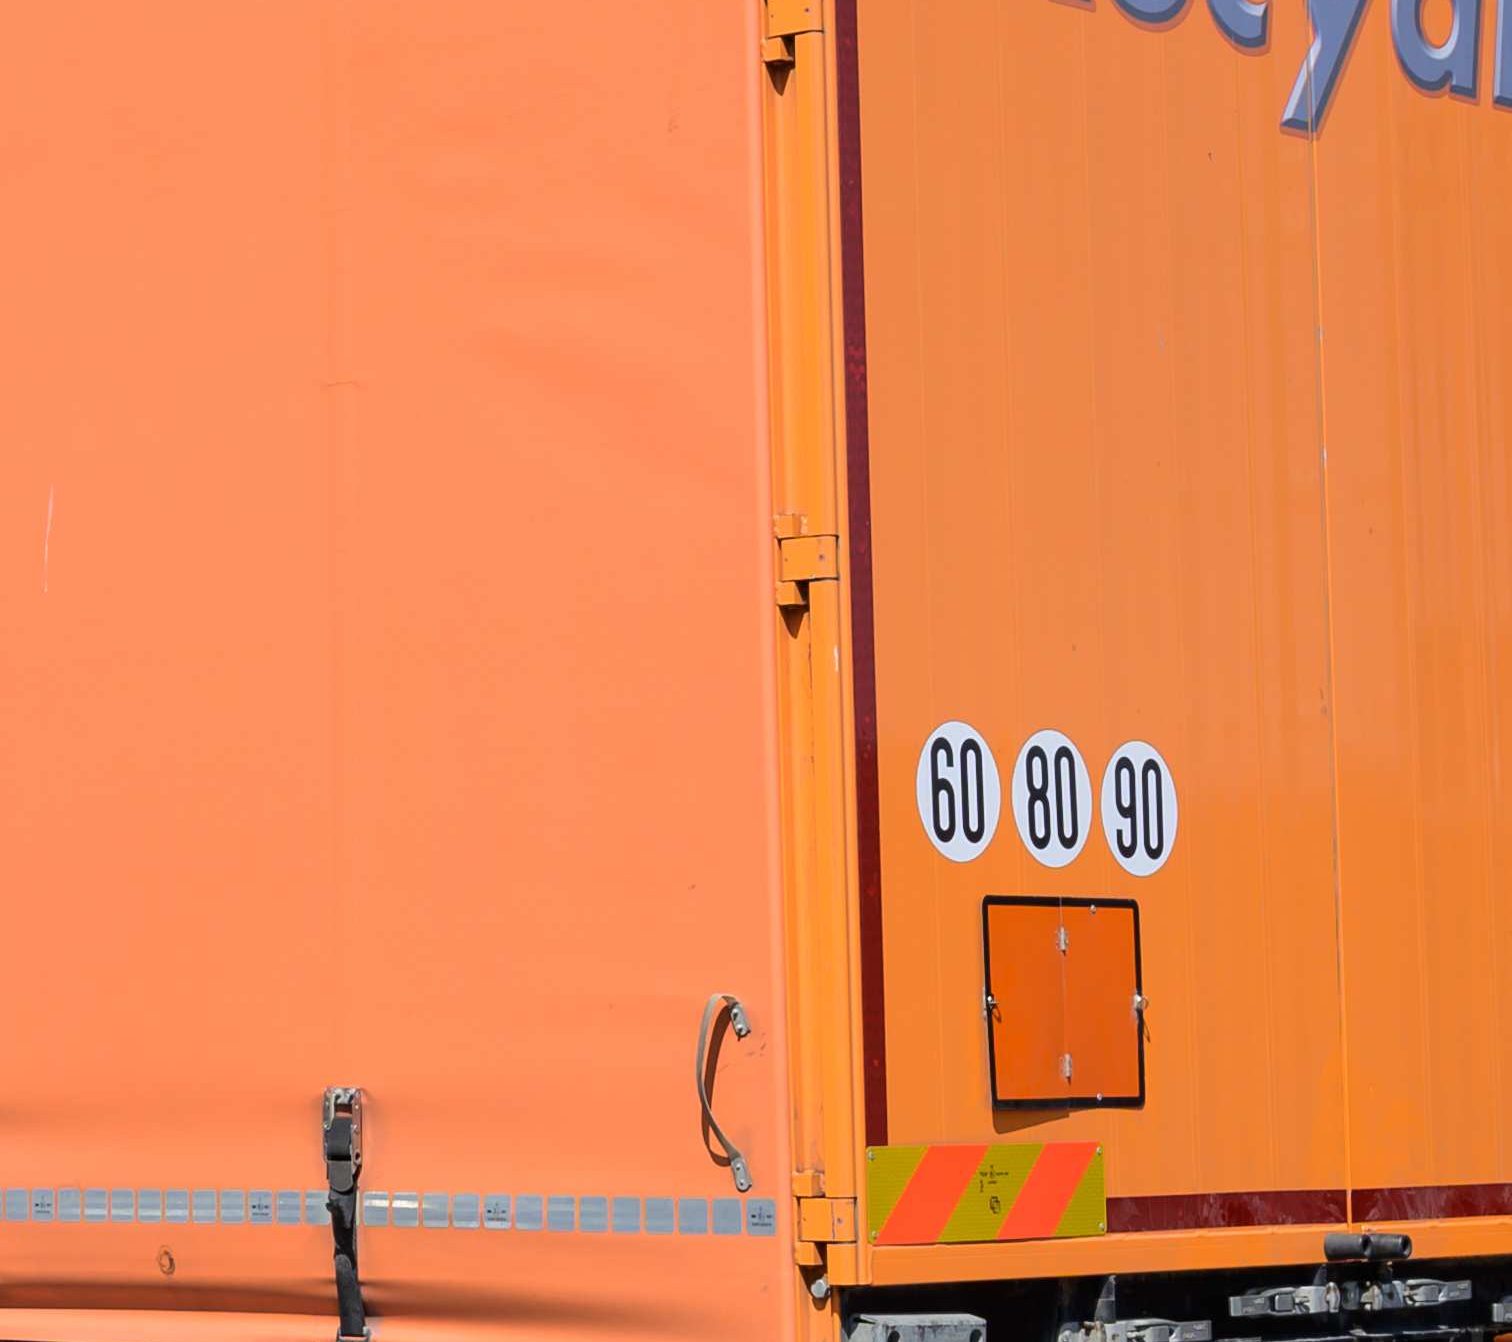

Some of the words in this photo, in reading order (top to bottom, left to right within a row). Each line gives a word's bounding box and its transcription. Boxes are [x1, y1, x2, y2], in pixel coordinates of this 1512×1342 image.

[930, 736, 985, 844] 60
[1026, 745, 1079, 850] 80
[1114, 756, 1164, 860] 90
